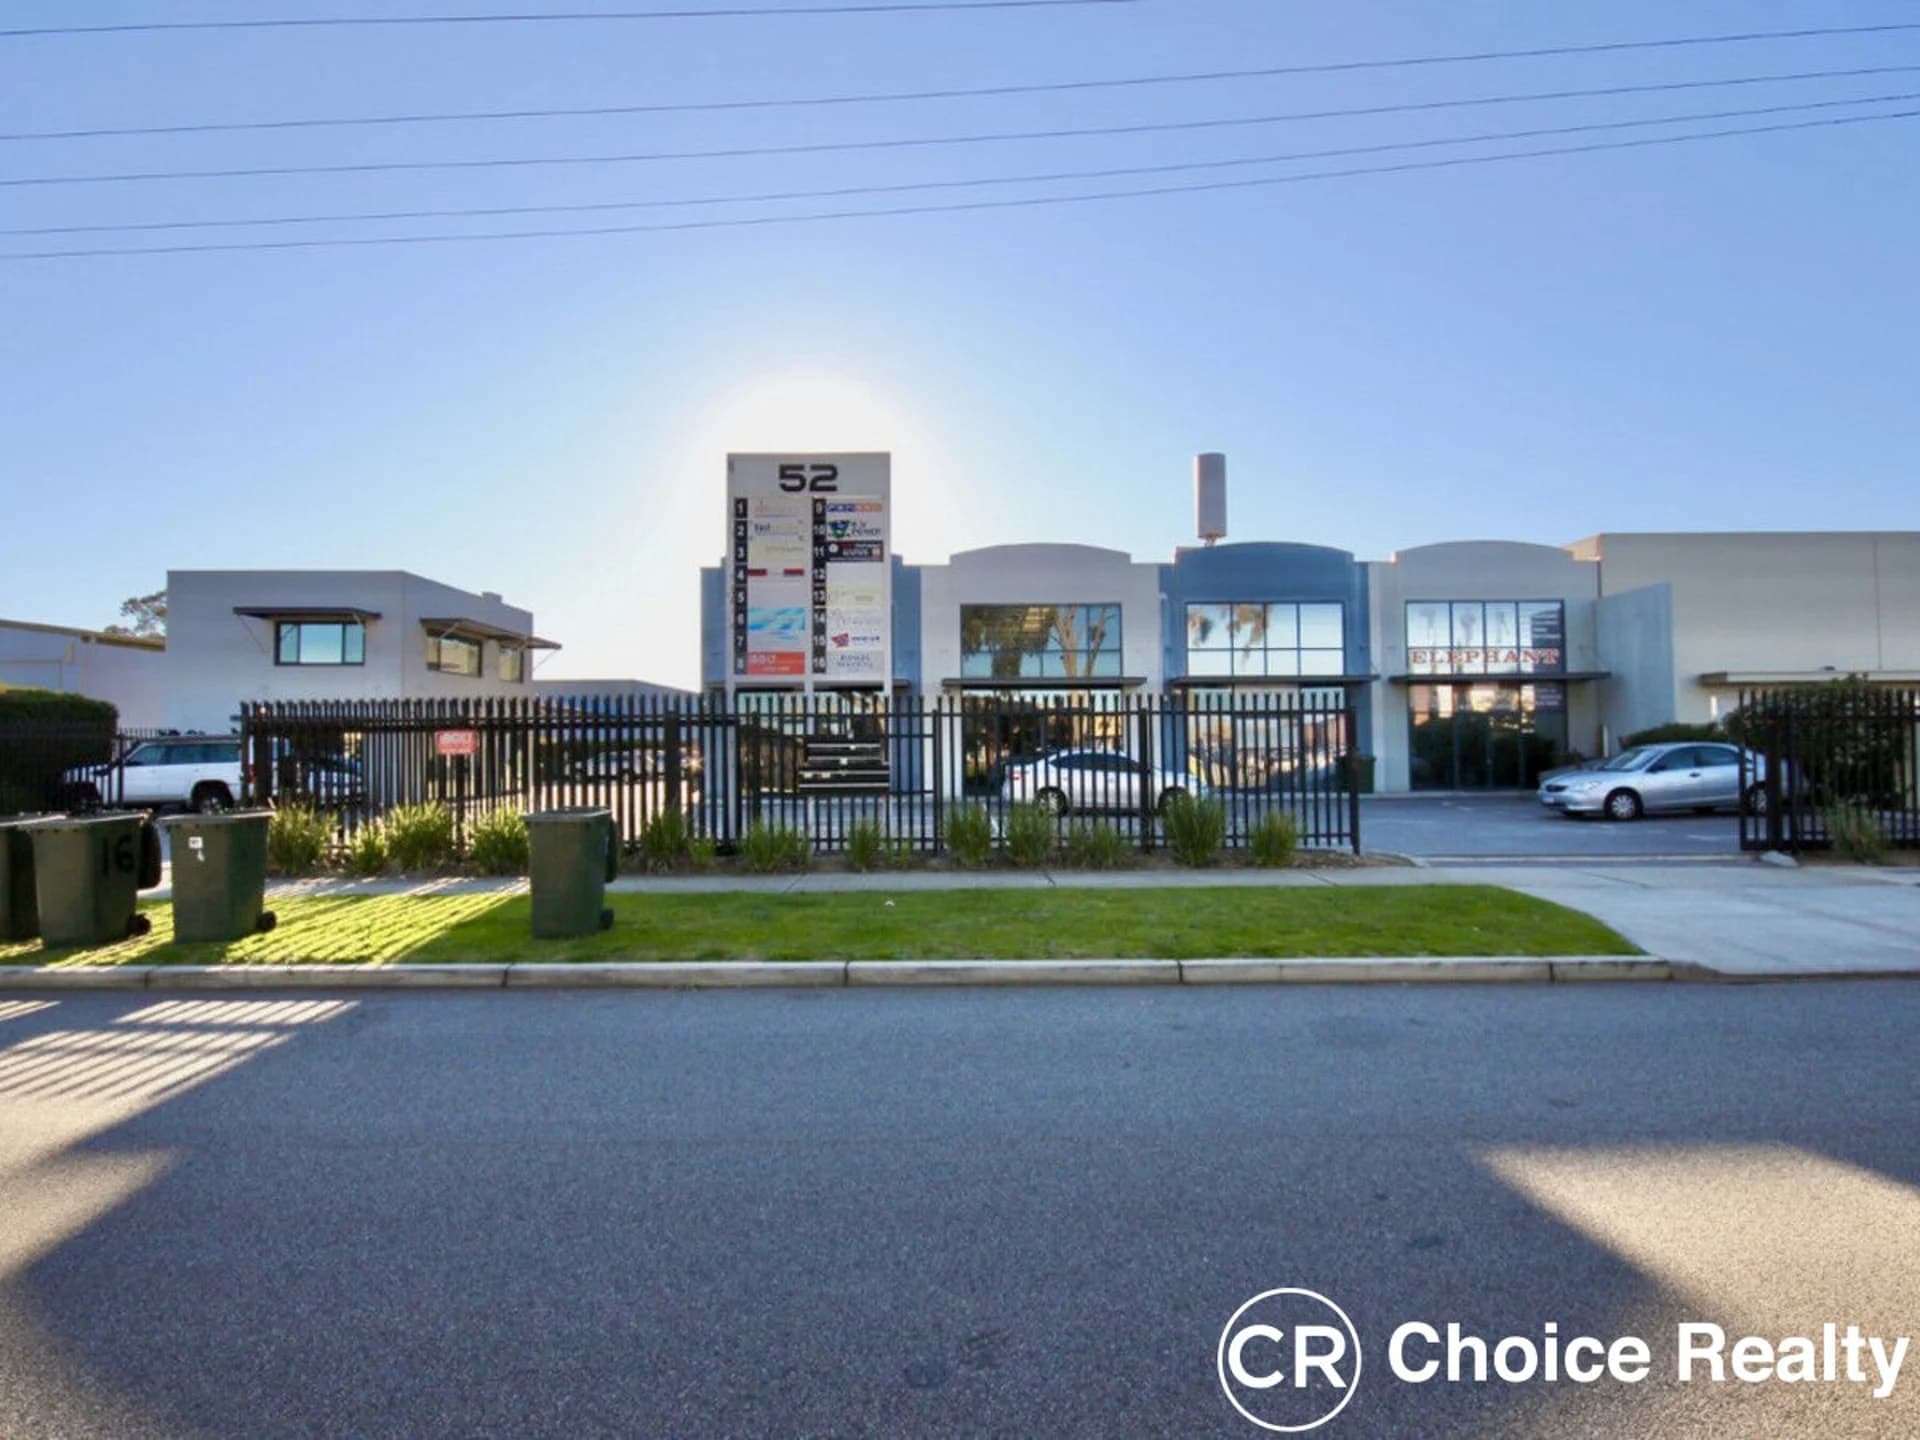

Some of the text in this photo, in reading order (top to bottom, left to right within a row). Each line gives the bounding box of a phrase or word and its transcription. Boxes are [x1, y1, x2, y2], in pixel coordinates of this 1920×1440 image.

[778, 463, 839, 492] 52
[813, 569, 826, 580] 12
[813, 612, 826, 624] 14
[1411, 648, 1560, 665] ELEPHANT
[102, 833, 136, 873] 16
